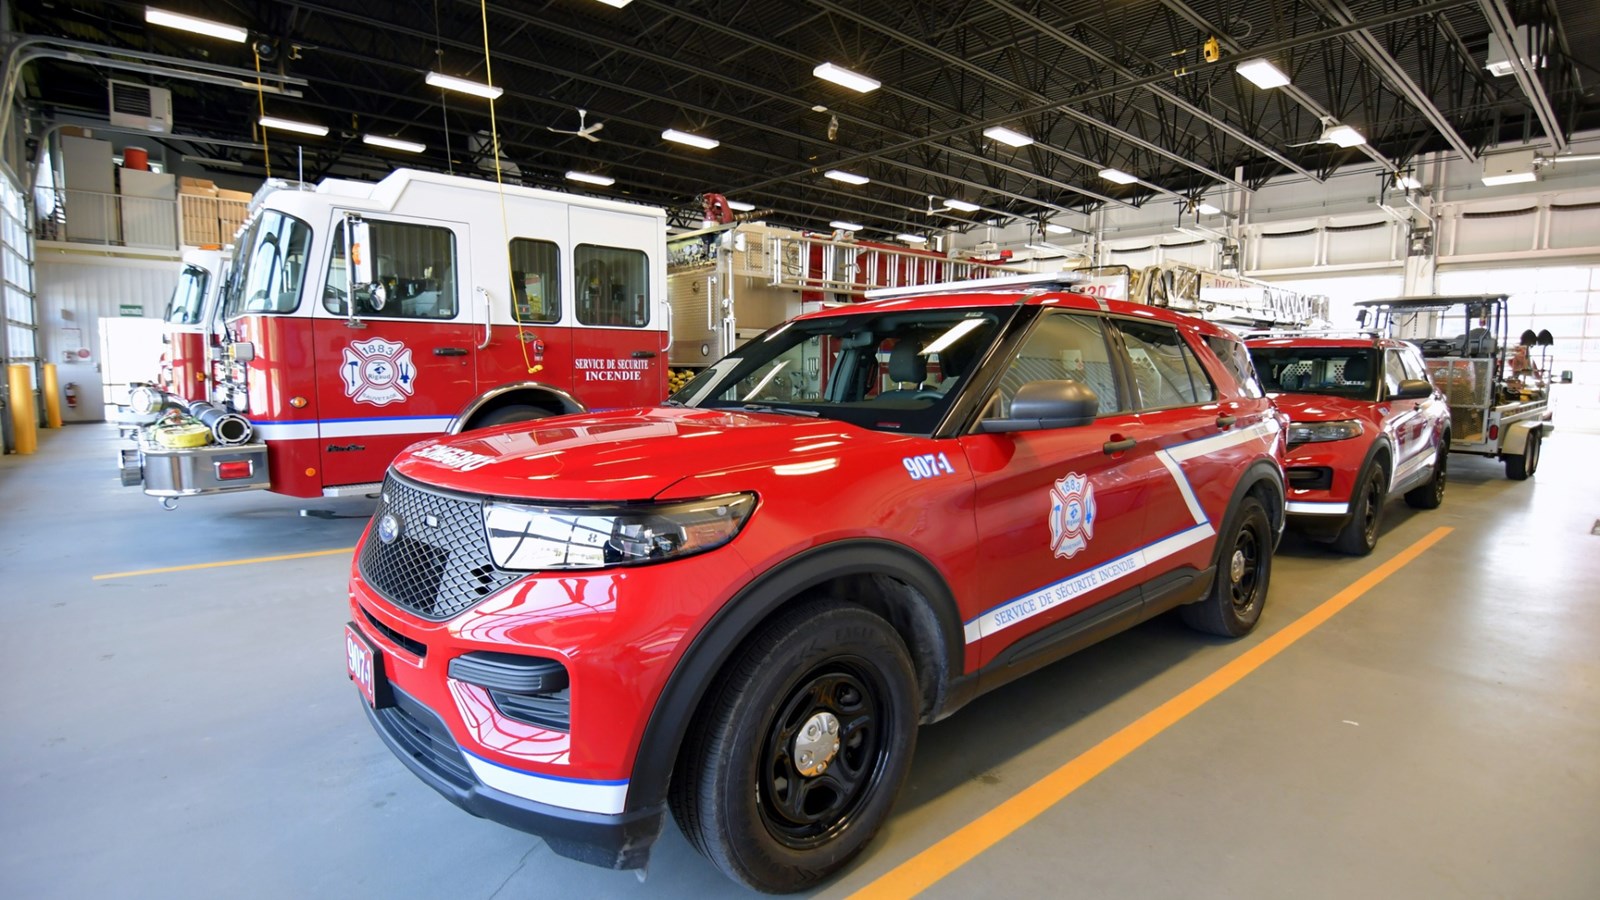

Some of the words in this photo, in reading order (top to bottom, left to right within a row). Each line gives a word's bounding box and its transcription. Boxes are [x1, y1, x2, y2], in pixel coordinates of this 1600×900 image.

[362, 344, 394, 355] 1883
[575, 358, 605, 369] SERVICE
[607, 359, 616, 369] DE
[368, 373, 391, 381] Rigaud
[586, 371, 641, 381] INCENDIE
[902, 451, 955, 480] 907-1
[1062, 479, 1081, 494] 1883
[994, 599, 1036, 627] SERVICE
[1038, 592, 1054, 608] DE
[1055, 573, 1098, 600] SÉCURITÉ
[1099, 557, 1136, 582] INCENDIE
[347, 636, 373, 695] 907-1
